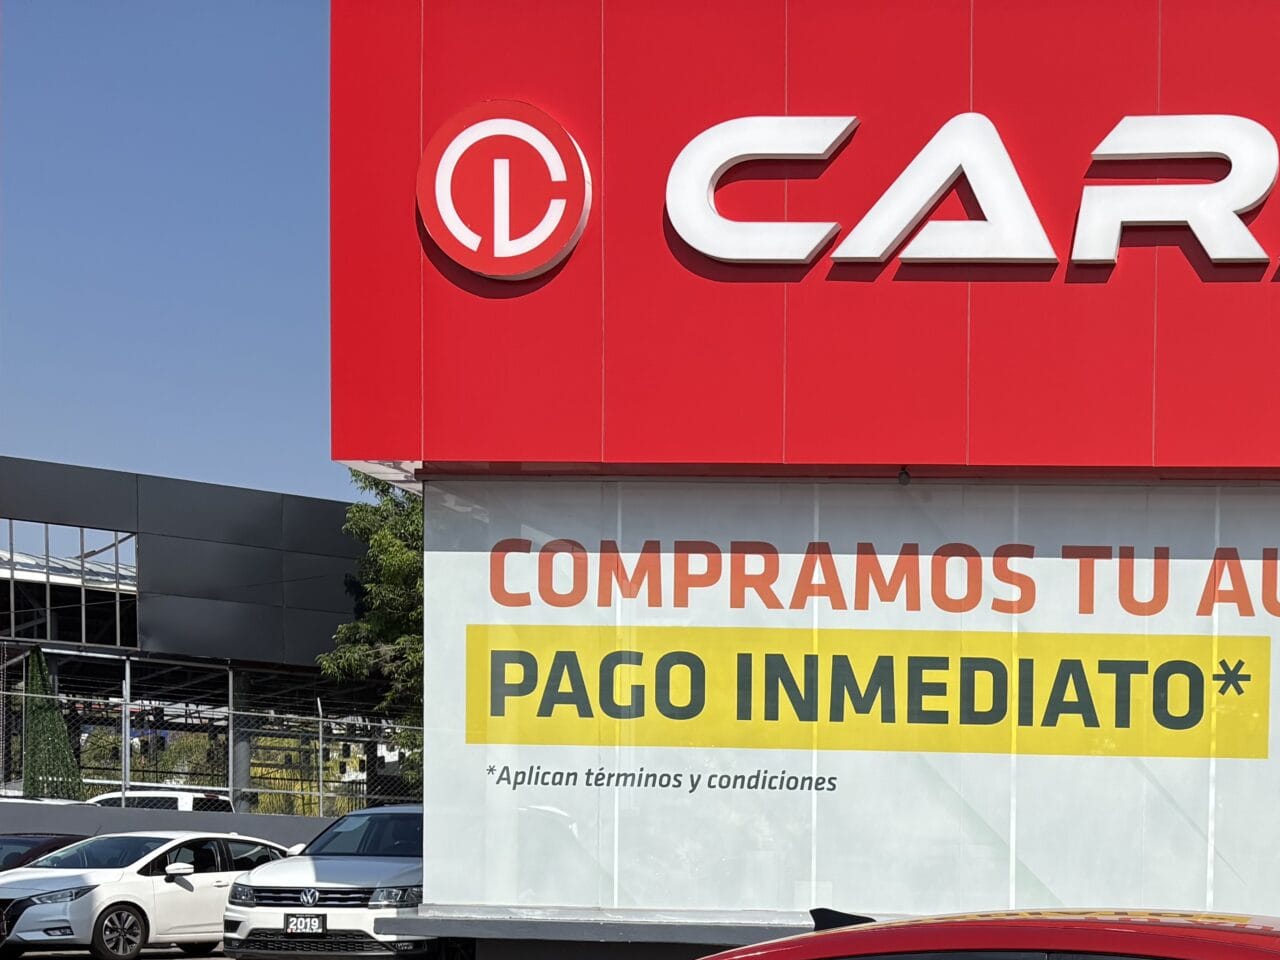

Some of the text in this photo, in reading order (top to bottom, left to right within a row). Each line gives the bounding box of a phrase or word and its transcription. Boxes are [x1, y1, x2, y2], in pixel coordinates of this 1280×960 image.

[489, 538, 1037, 615] COMPRAMOS
[1061, 544, 1170, 617] TU
[490, 649, 706, 720] PAGO
[584, 766, 683, 788] términos
[688, 773, 702, 794] y
[706, 769, 838, 792] condiciones
[289, 917, 319, 929] 2019
